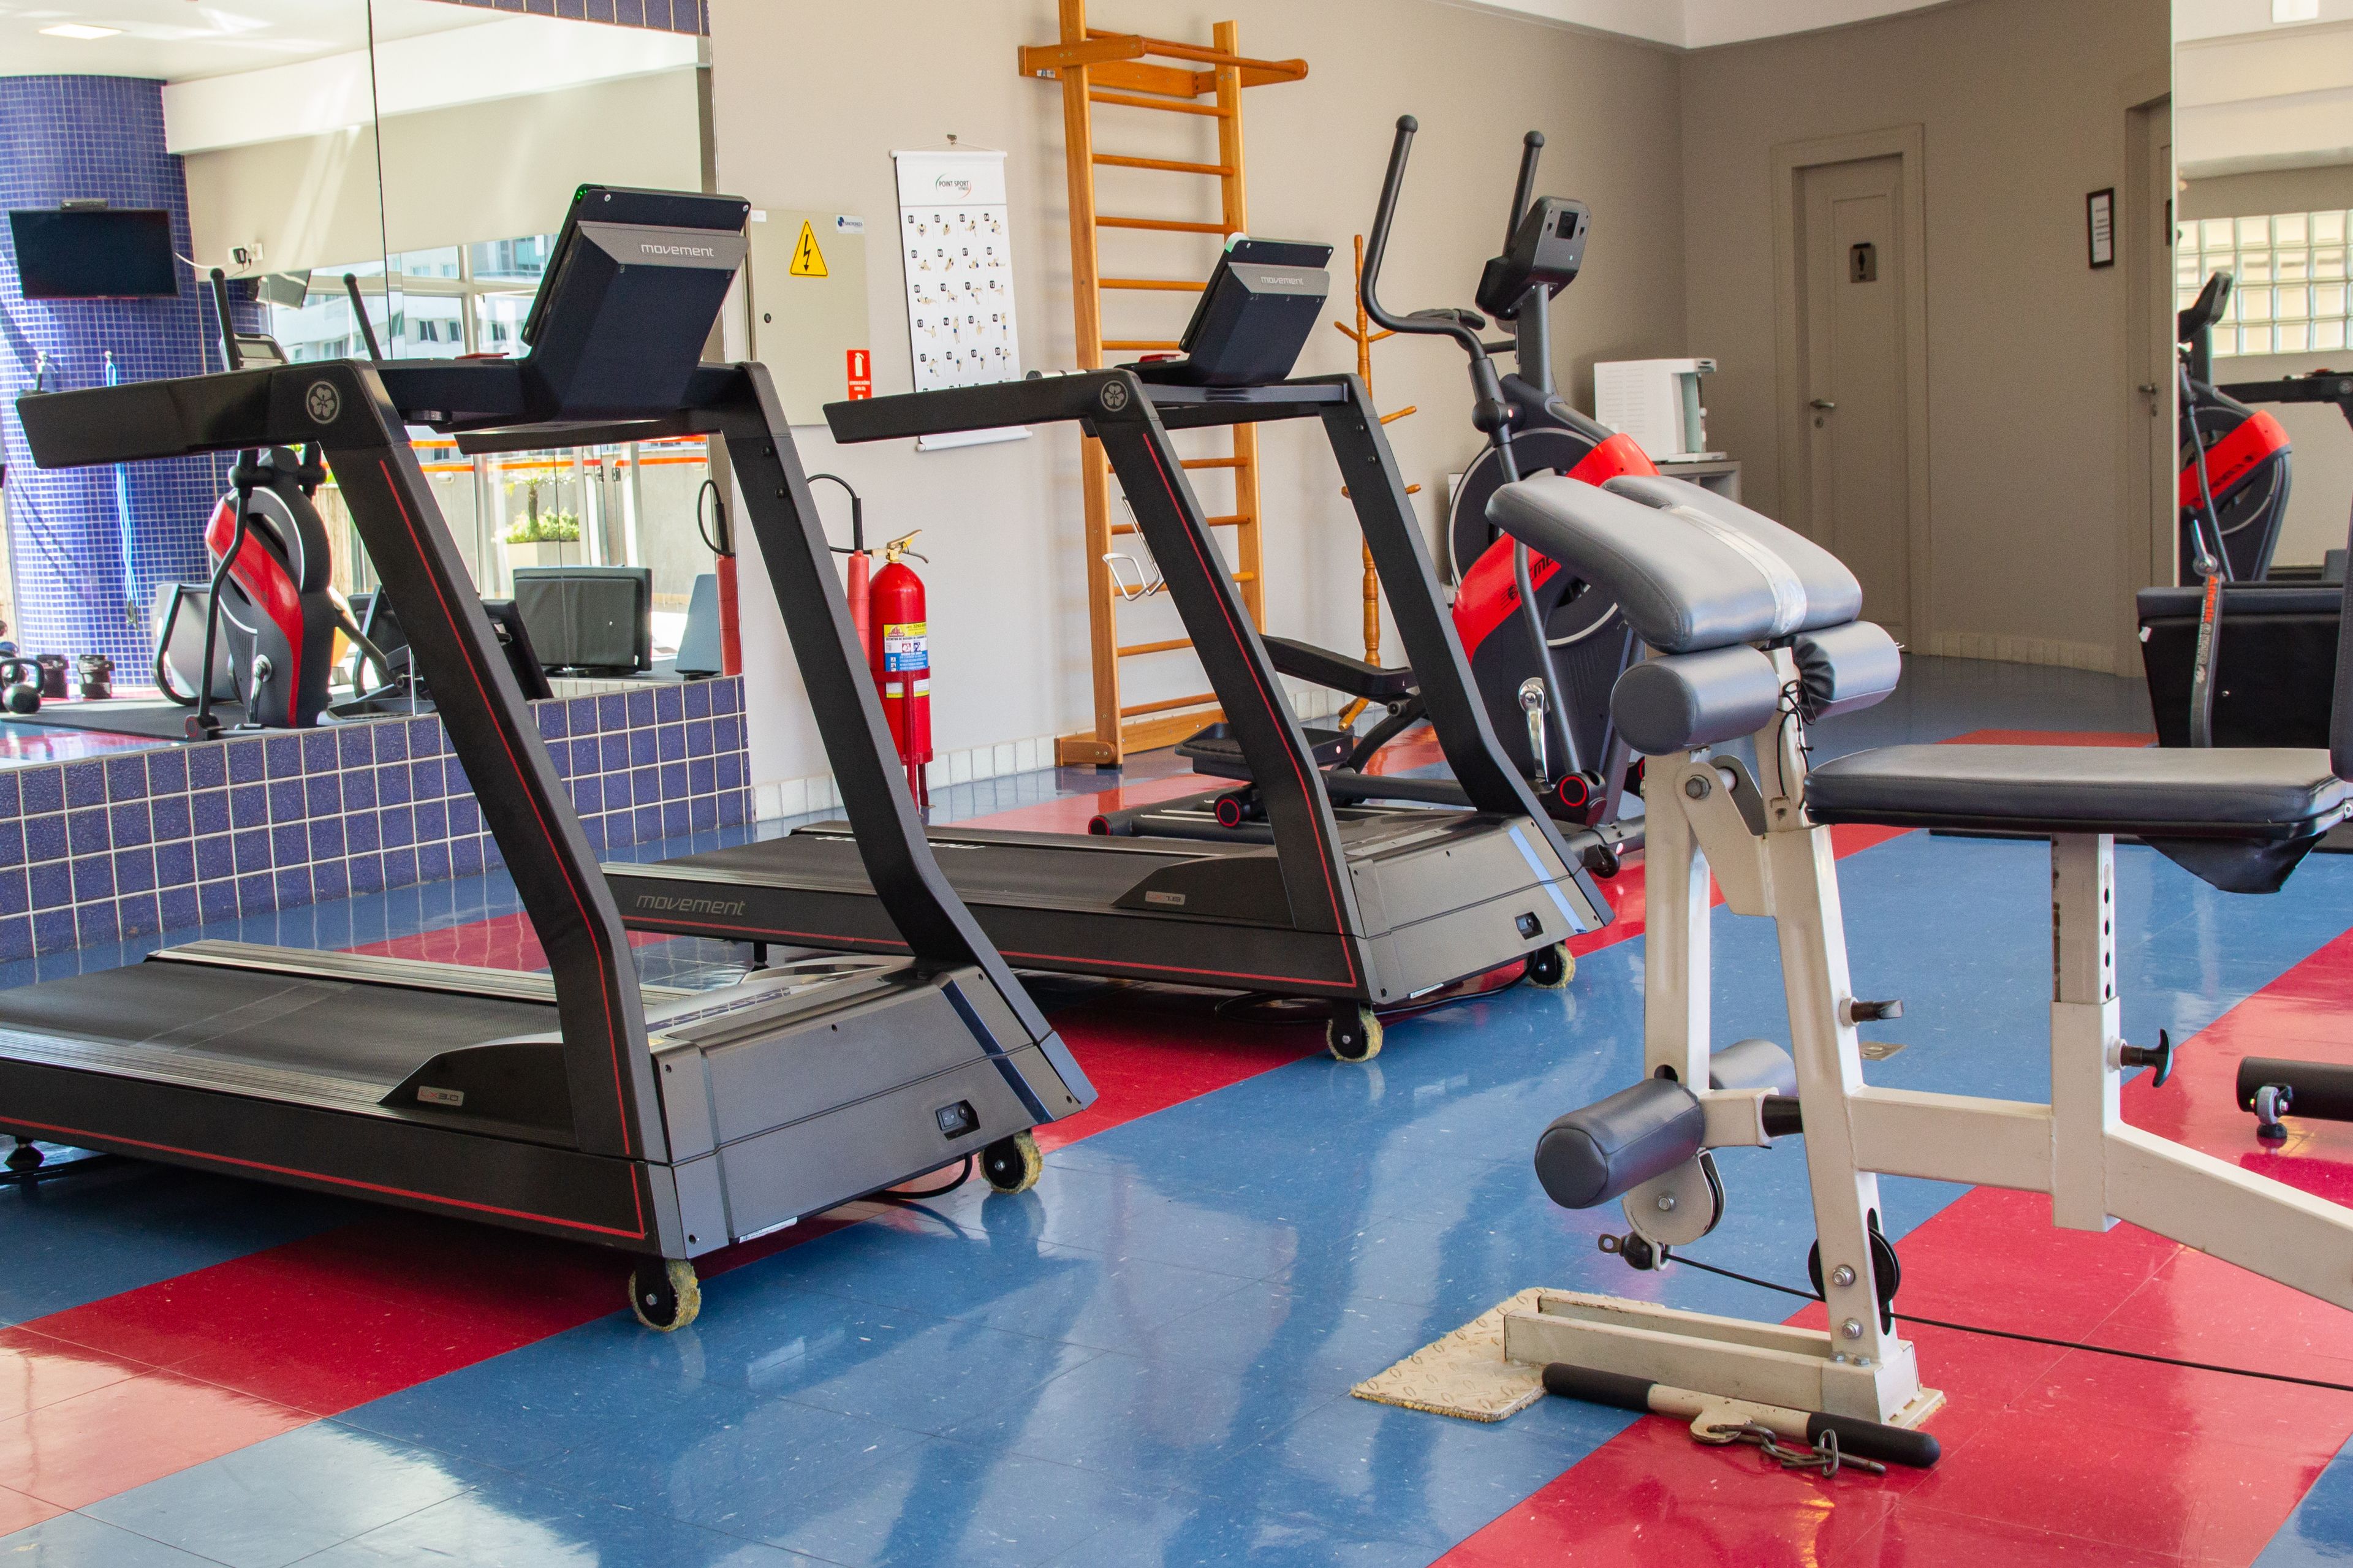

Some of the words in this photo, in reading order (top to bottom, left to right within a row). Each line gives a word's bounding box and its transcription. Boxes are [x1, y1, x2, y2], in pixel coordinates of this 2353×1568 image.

[641, 244, 714, 257] movement
[1260, 276, 1304, 285] movement
[636, 895, 746, 916] movement
